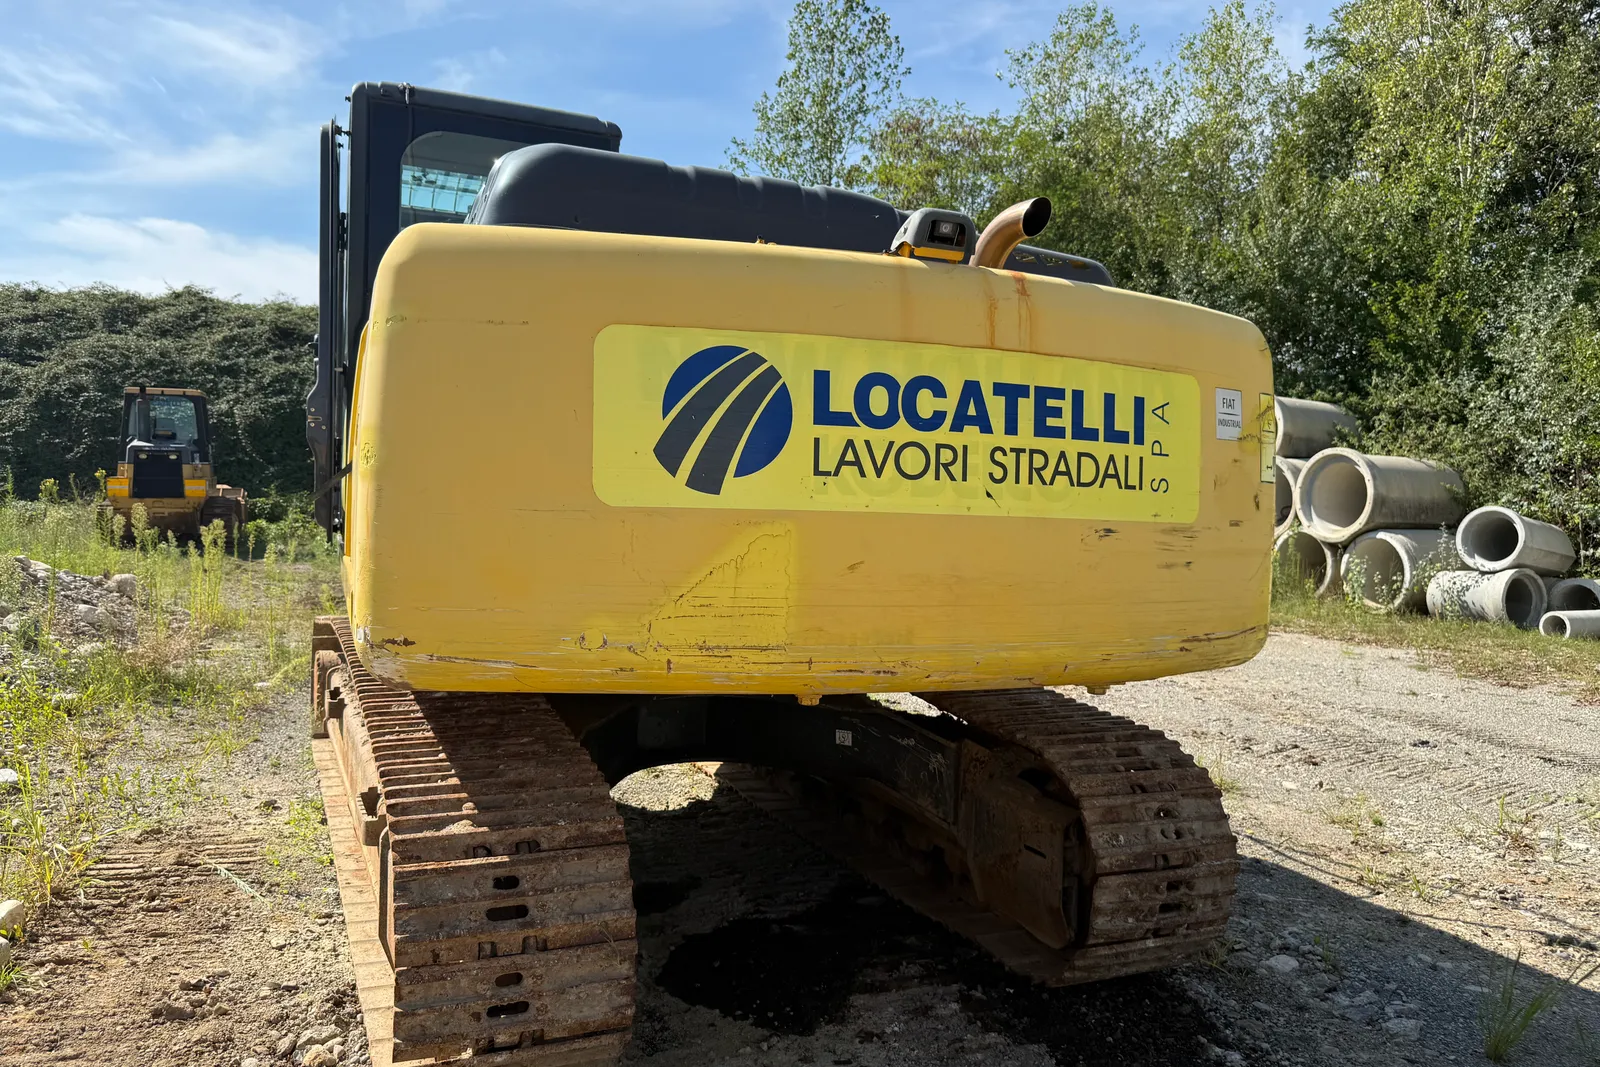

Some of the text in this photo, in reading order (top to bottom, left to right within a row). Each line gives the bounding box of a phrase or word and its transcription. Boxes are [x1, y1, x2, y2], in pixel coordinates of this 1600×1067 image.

[812, 369, 1146, 446] LOCATELLI
[1222, 397, 1236, 410] FIAT
[1217, 418, 1242, 429] INDUSTRIAL
[812, 436, 1144, 492] LAVORI STRADALI
